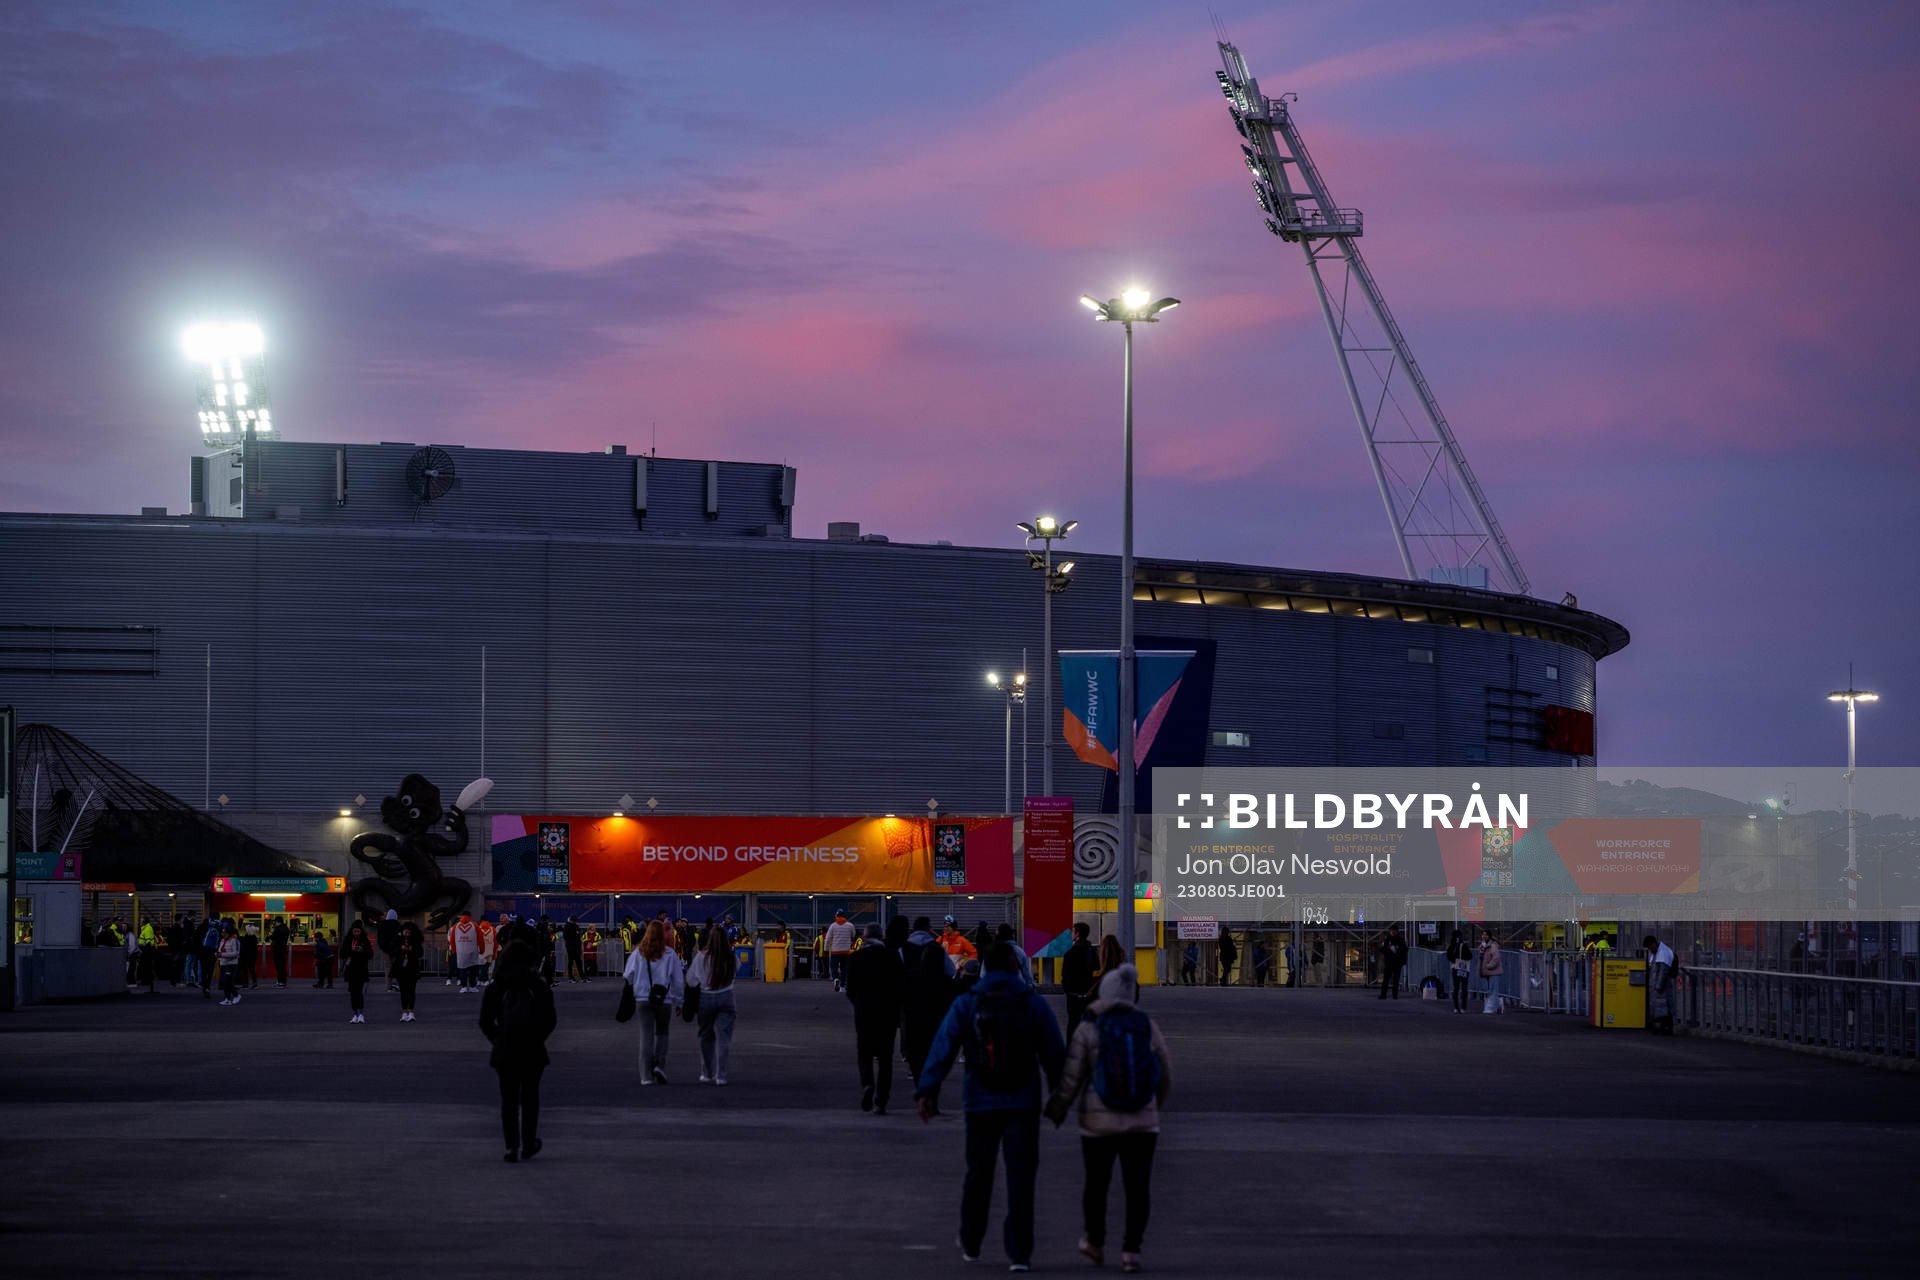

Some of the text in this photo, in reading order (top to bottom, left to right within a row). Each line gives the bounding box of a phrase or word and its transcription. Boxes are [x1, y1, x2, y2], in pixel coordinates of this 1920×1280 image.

[1086, 670, 1099, 749] #FIFAWWC
[1327, 833, 1404, 842] HOSPITALITY
[1595, 839, 1672, 848] WORKFORCE
[1190, 845, 1276, 854] VIP ENTRANCE
[1333, 845, 1398, 853] ENTRANCE
[642, 846, 859, 863] BEYOND GREATNESS
[1600, 851, 1665, 859] ENTRANCE
